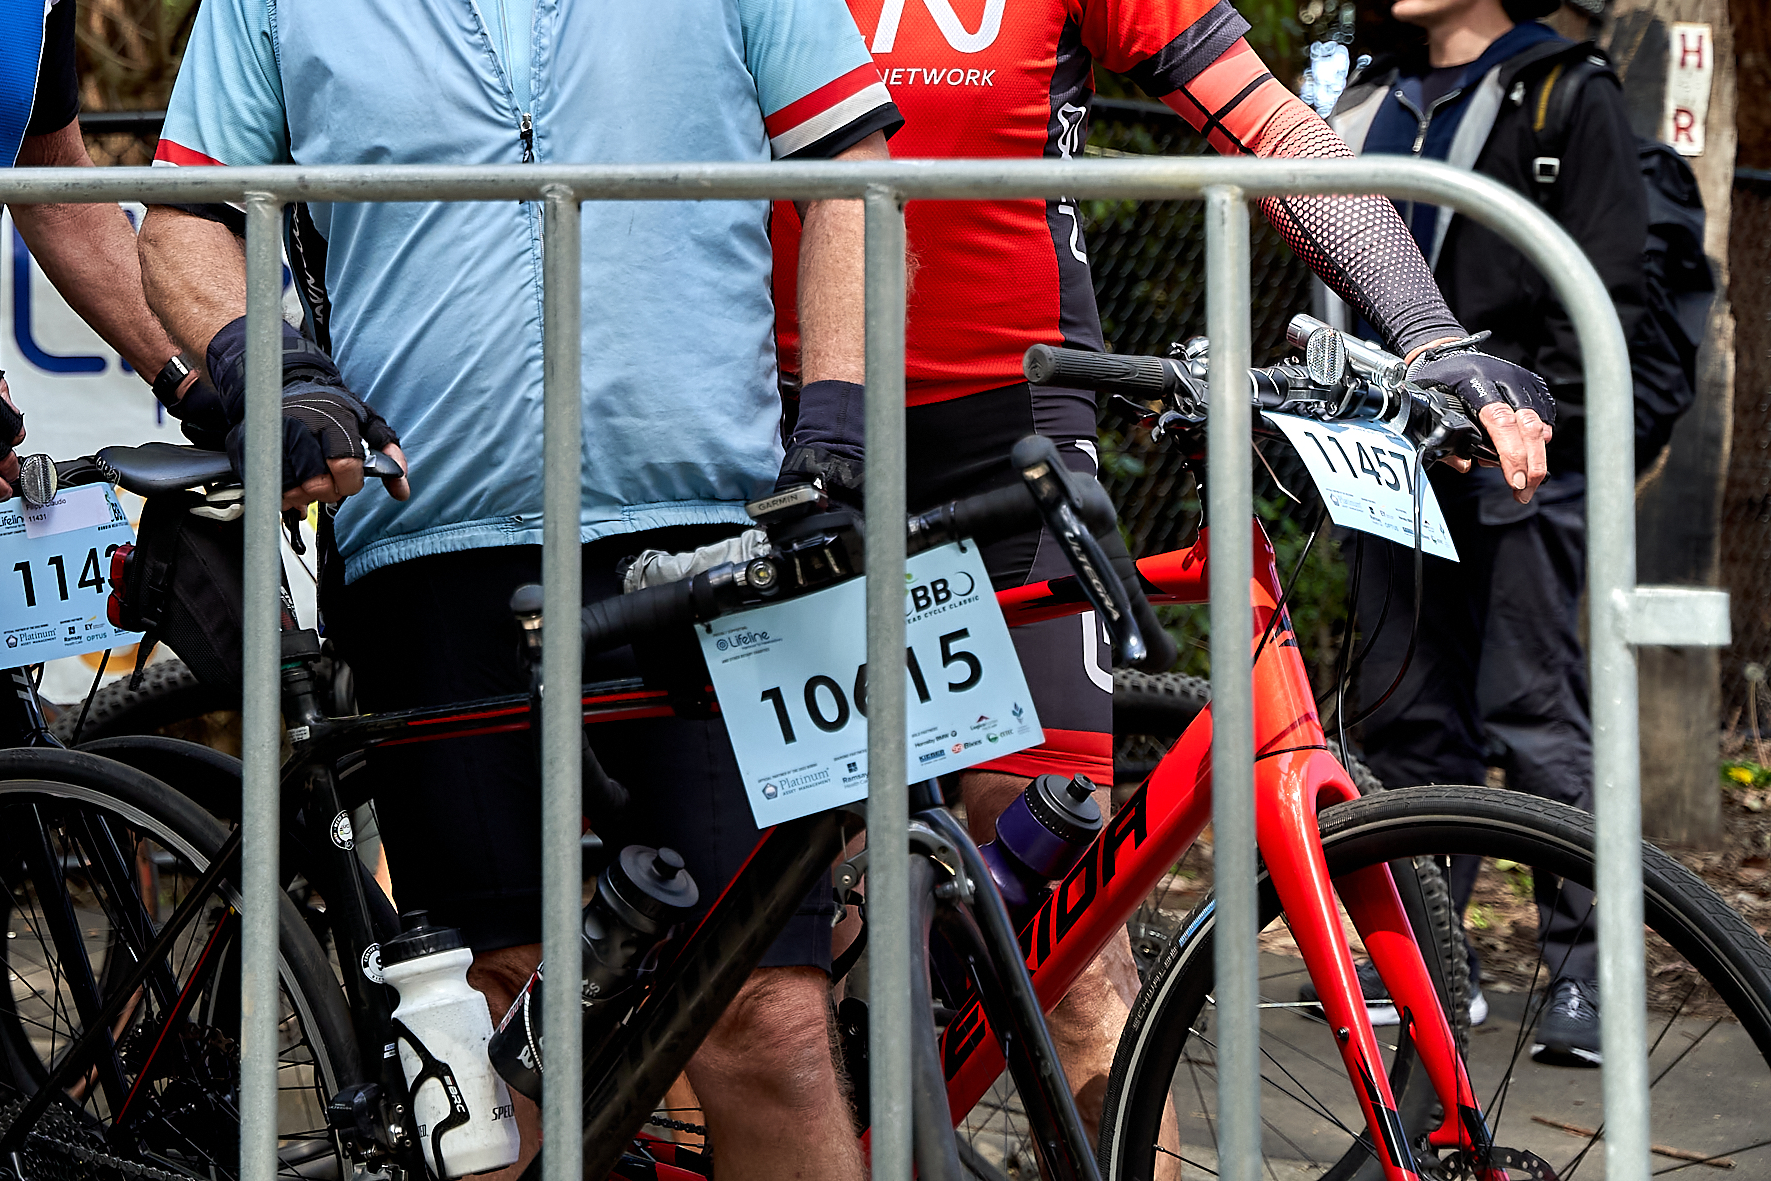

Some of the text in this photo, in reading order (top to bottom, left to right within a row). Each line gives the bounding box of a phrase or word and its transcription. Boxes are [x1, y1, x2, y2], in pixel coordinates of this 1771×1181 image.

[1680, 34, 1703, 68] H
[1674, 108, 1695, 143] R
[1303, 431, 1415, 496] 11457
[758, 494, 798, 511] GARMIN
[29, 514, 47, 523] 11431
[907, 595, 980, 624] EAD CYCLE CLASSIC
[20, 627, 56, 642] Platinum
[86, 633, 107, 642] OPTUS
[728, 631, 770, 647] Lifeline
[779, 767, 830, 791] Platinum
